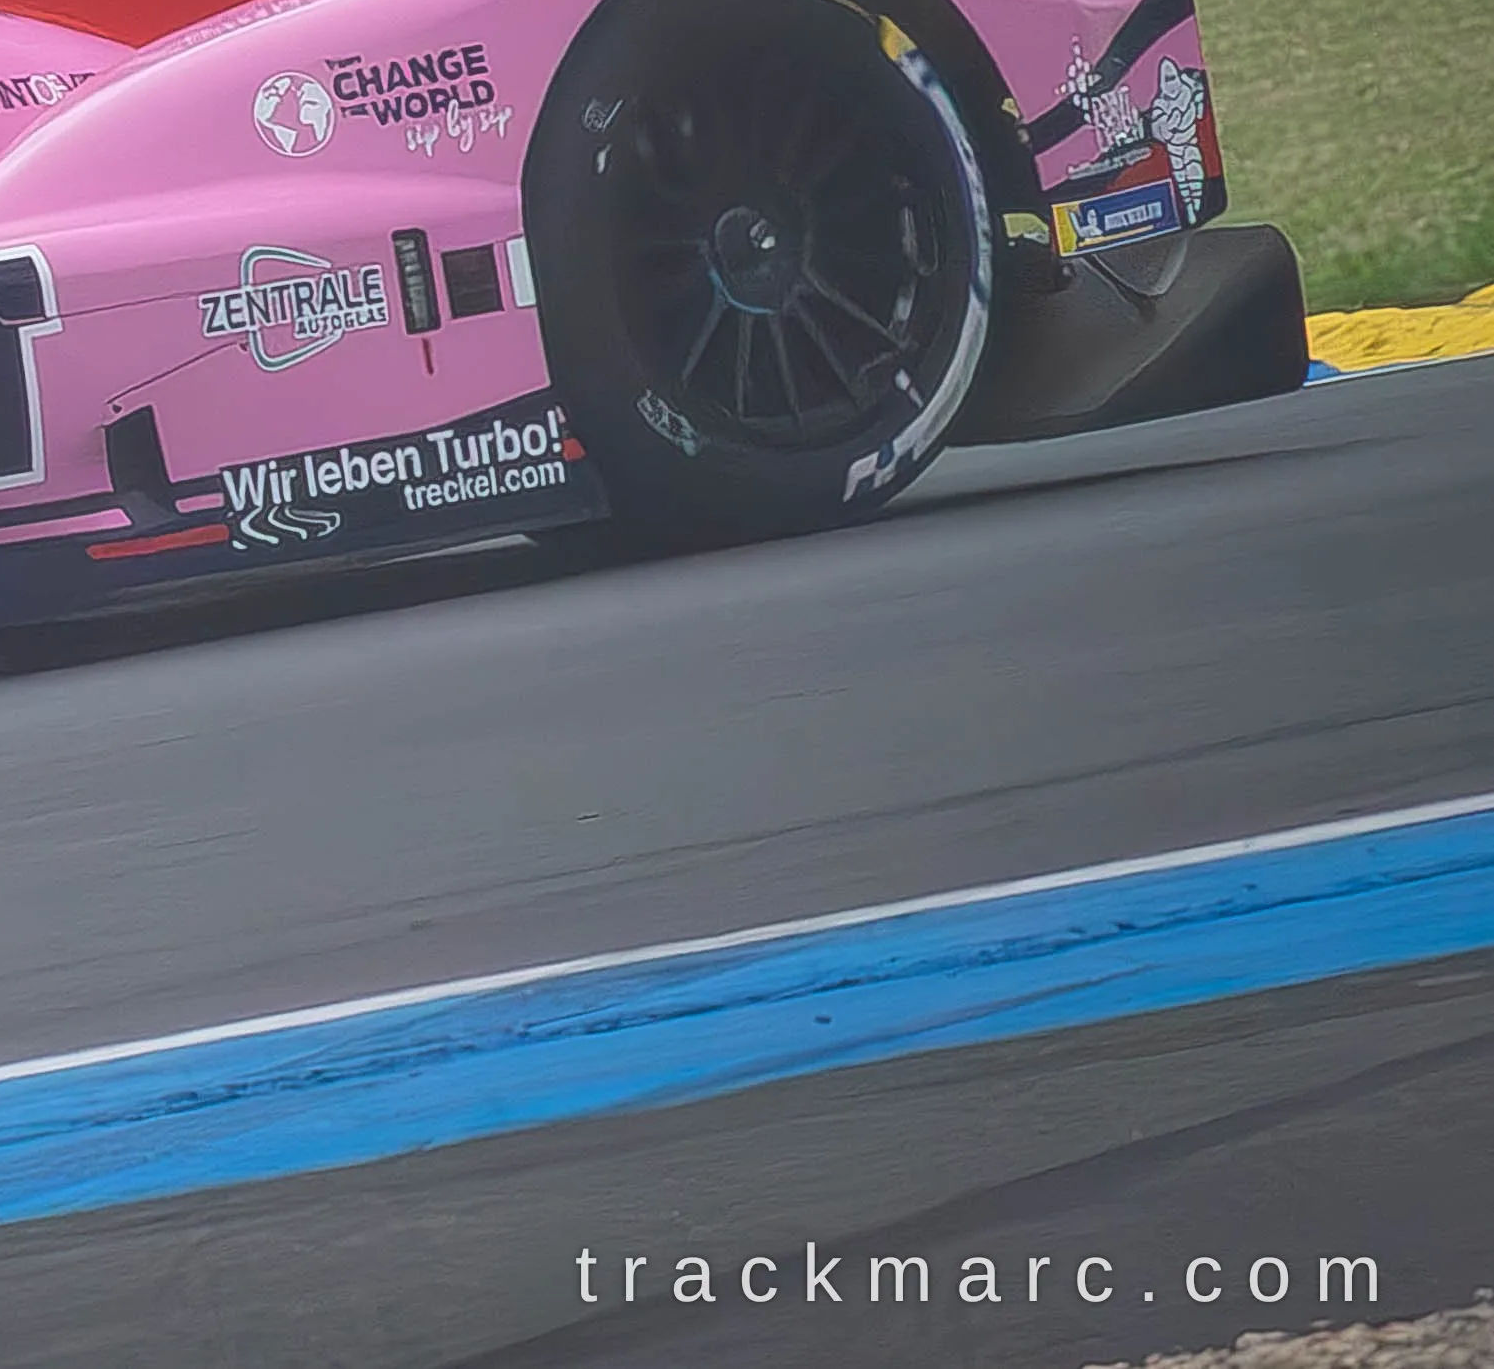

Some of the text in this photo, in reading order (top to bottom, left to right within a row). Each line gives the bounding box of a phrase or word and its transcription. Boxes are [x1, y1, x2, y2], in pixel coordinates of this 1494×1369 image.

[332, 43, 489, 101] CHANGE
[371, 80, 495, 126] WORLD
[201, 268, 385, 333] ZENTRALE
[295, 306, 387, 336] AUTOGLAS
[223, 409, 563, 512] Wir leben Turbo!
[404, 461, 566, 510] treckel.com
